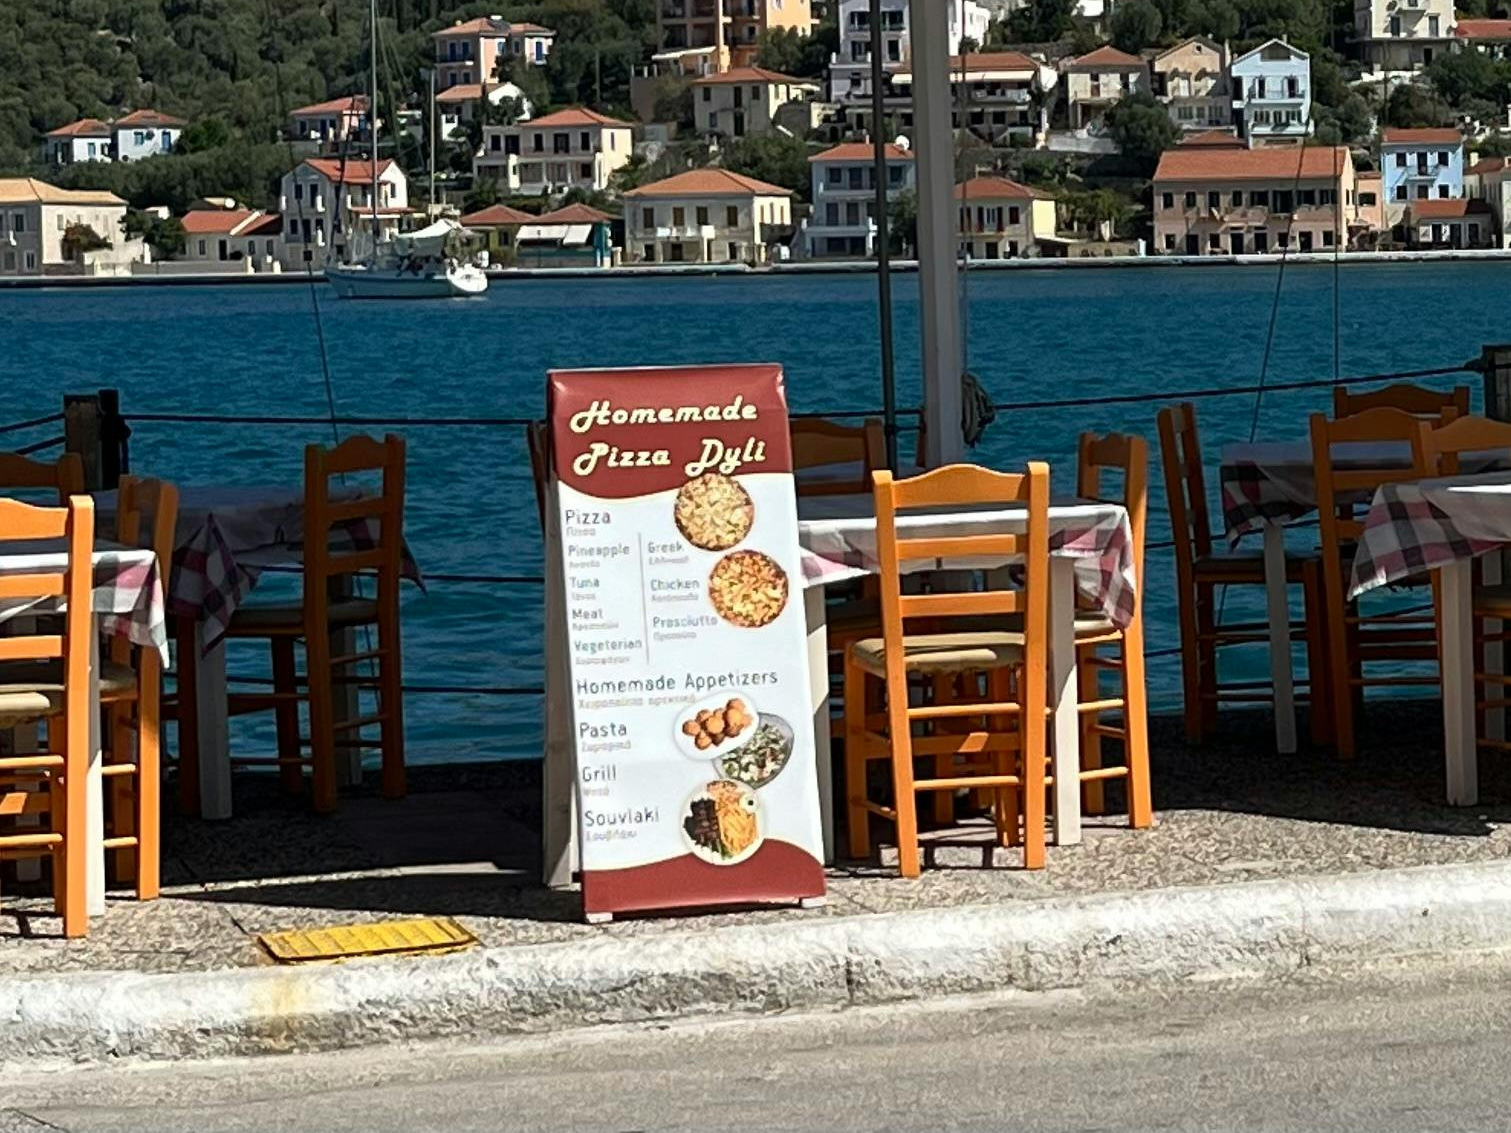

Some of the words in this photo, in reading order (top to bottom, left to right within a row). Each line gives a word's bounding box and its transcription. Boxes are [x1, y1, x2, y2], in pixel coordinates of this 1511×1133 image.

[569, 395, 758, 434] Homemade
[572, 442, 671, 477] Pizza
[565, 509, 611, 525] Pizza
[567, 542, 631, 558] Pineapple
[647, 541, 685, 554] Greek
[569, 576, 600, 589] Tuna
[650, 578, 700, 592] Chicken
[576, 674, 677, 695] Homemade
[685, 670, 779, 692] Appetizers
[579, 720, 628, 739] Pasta
[582, 764, 617, 783] Grill
[584, 806, 660, 828] Souvlaki
